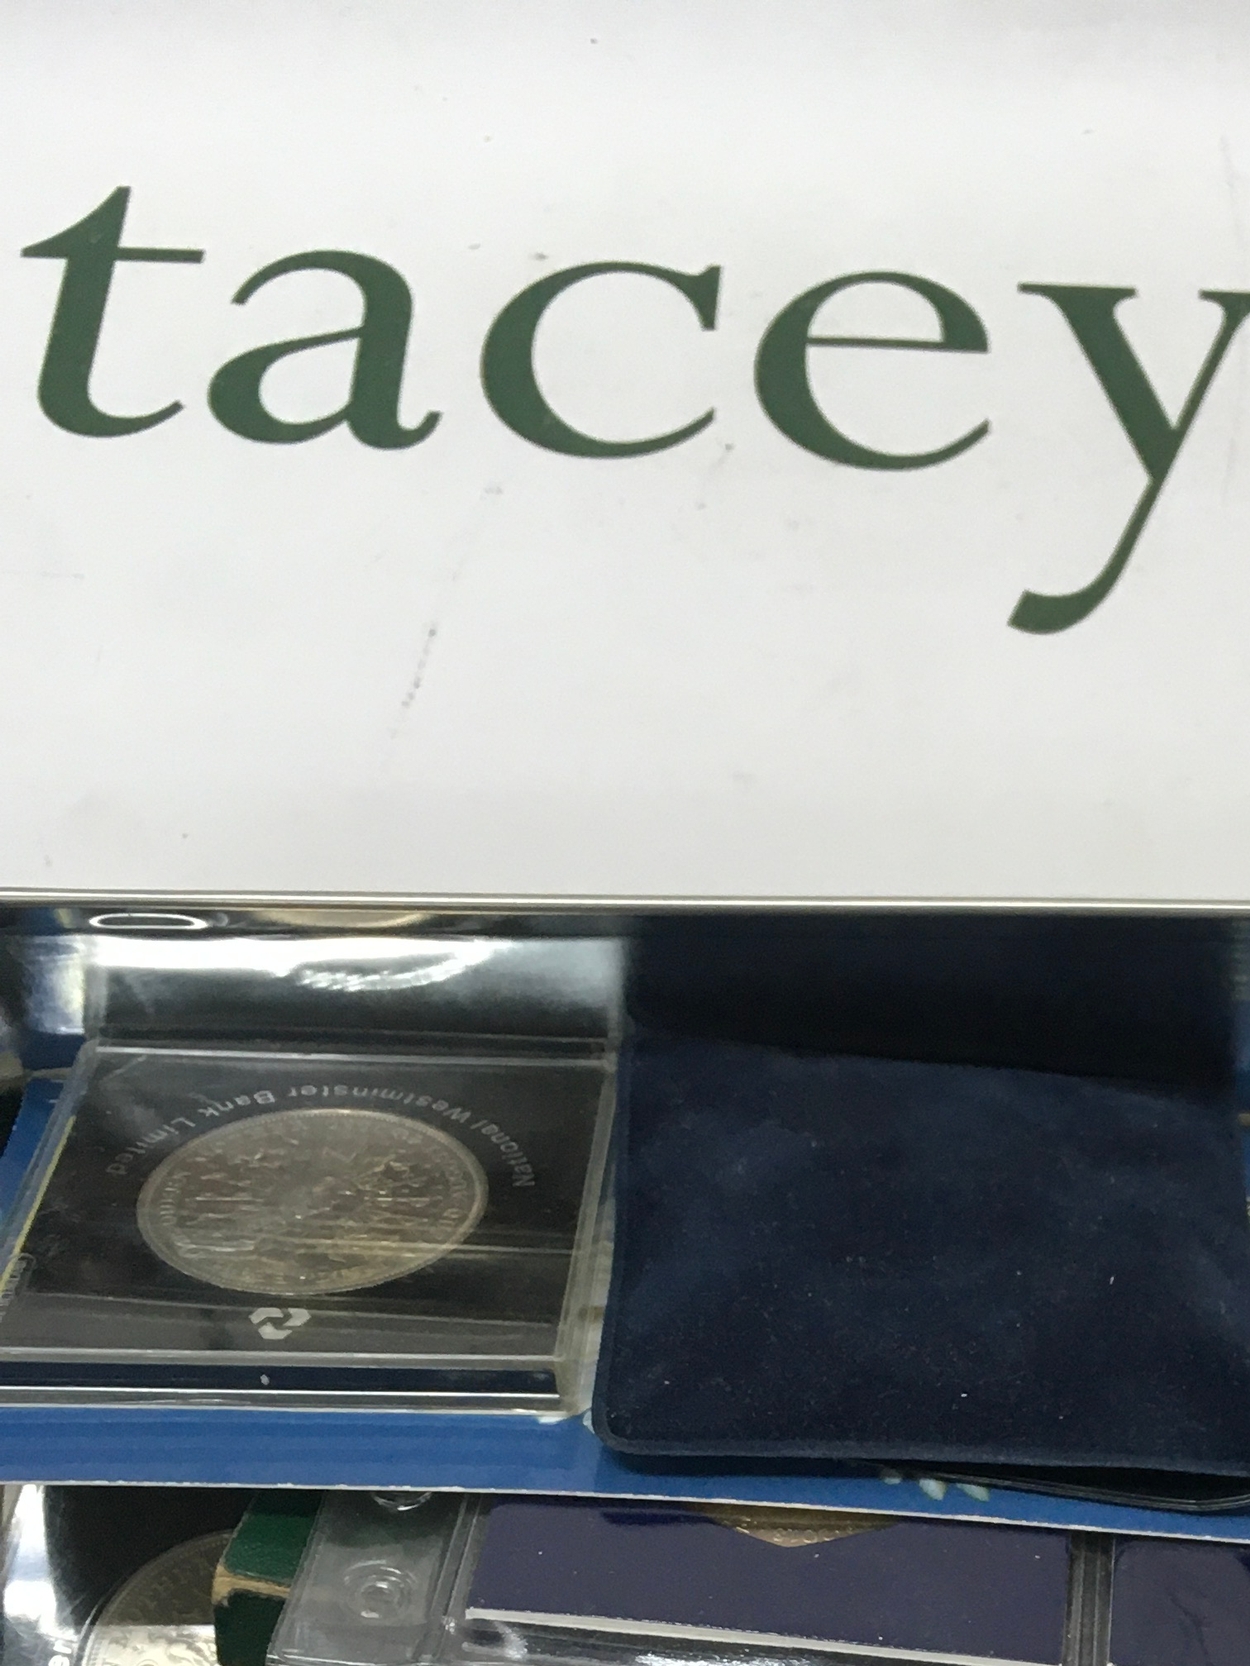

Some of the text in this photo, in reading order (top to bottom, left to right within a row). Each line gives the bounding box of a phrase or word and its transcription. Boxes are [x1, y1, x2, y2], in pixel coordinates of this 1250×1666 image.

[105, 1082, 536, 1188] National Westminster Bank Limited
